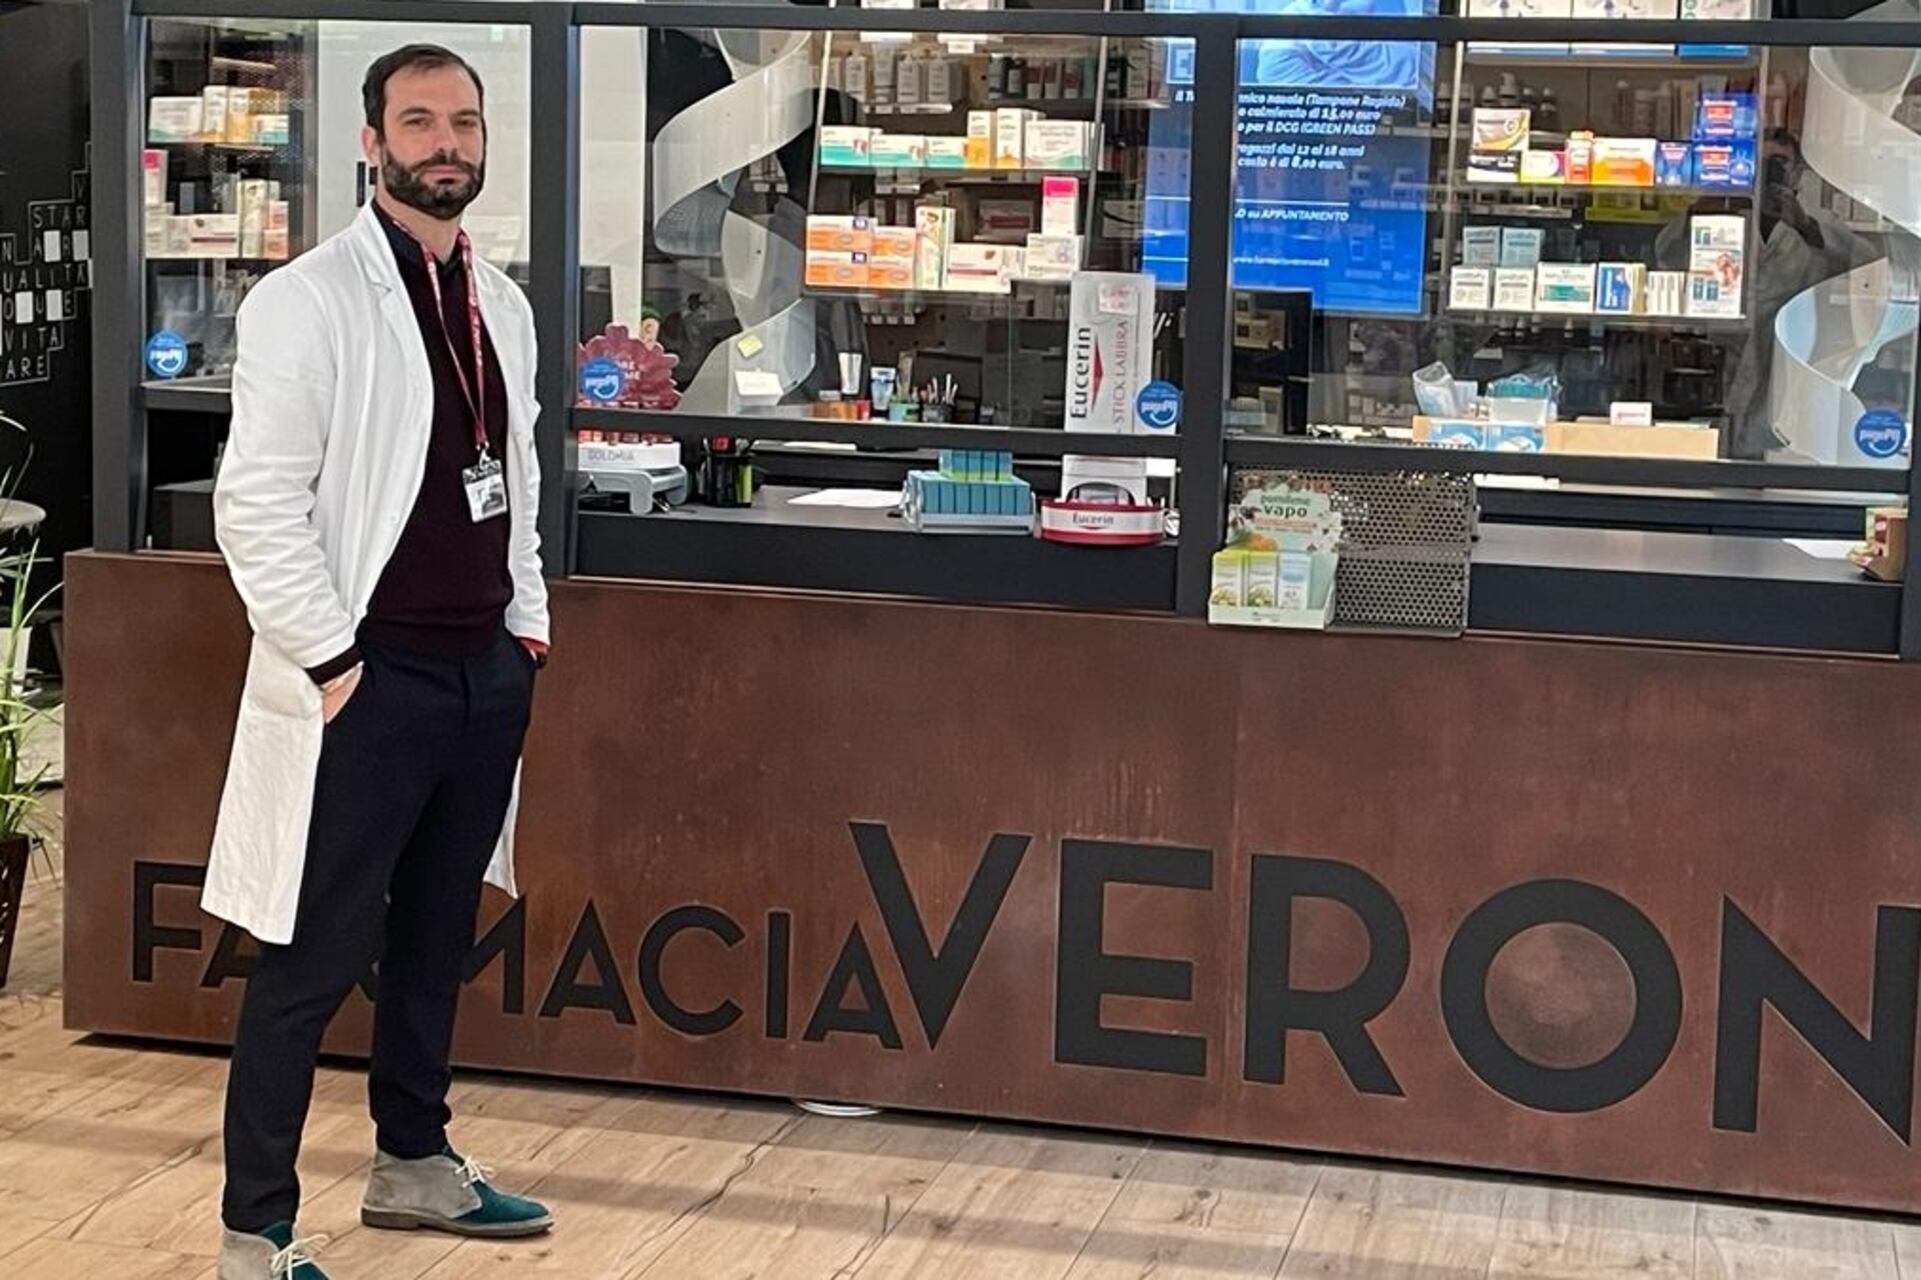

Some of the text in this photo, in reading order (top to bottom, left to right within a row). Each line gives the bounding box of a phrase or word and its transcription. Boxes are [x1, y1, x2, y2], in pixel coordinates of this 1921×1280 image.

[1355, 111, 1381, 120] euro
[1261, 209, 1349, 222] APPUNTAMENTO
[1070, 327, 1091, 419] Eucerin
[1113, 381, 1127, 425] STICK
[1264, 504, 1307, 519] vapo
[1072, 513, 1115, 525] Eucerin
